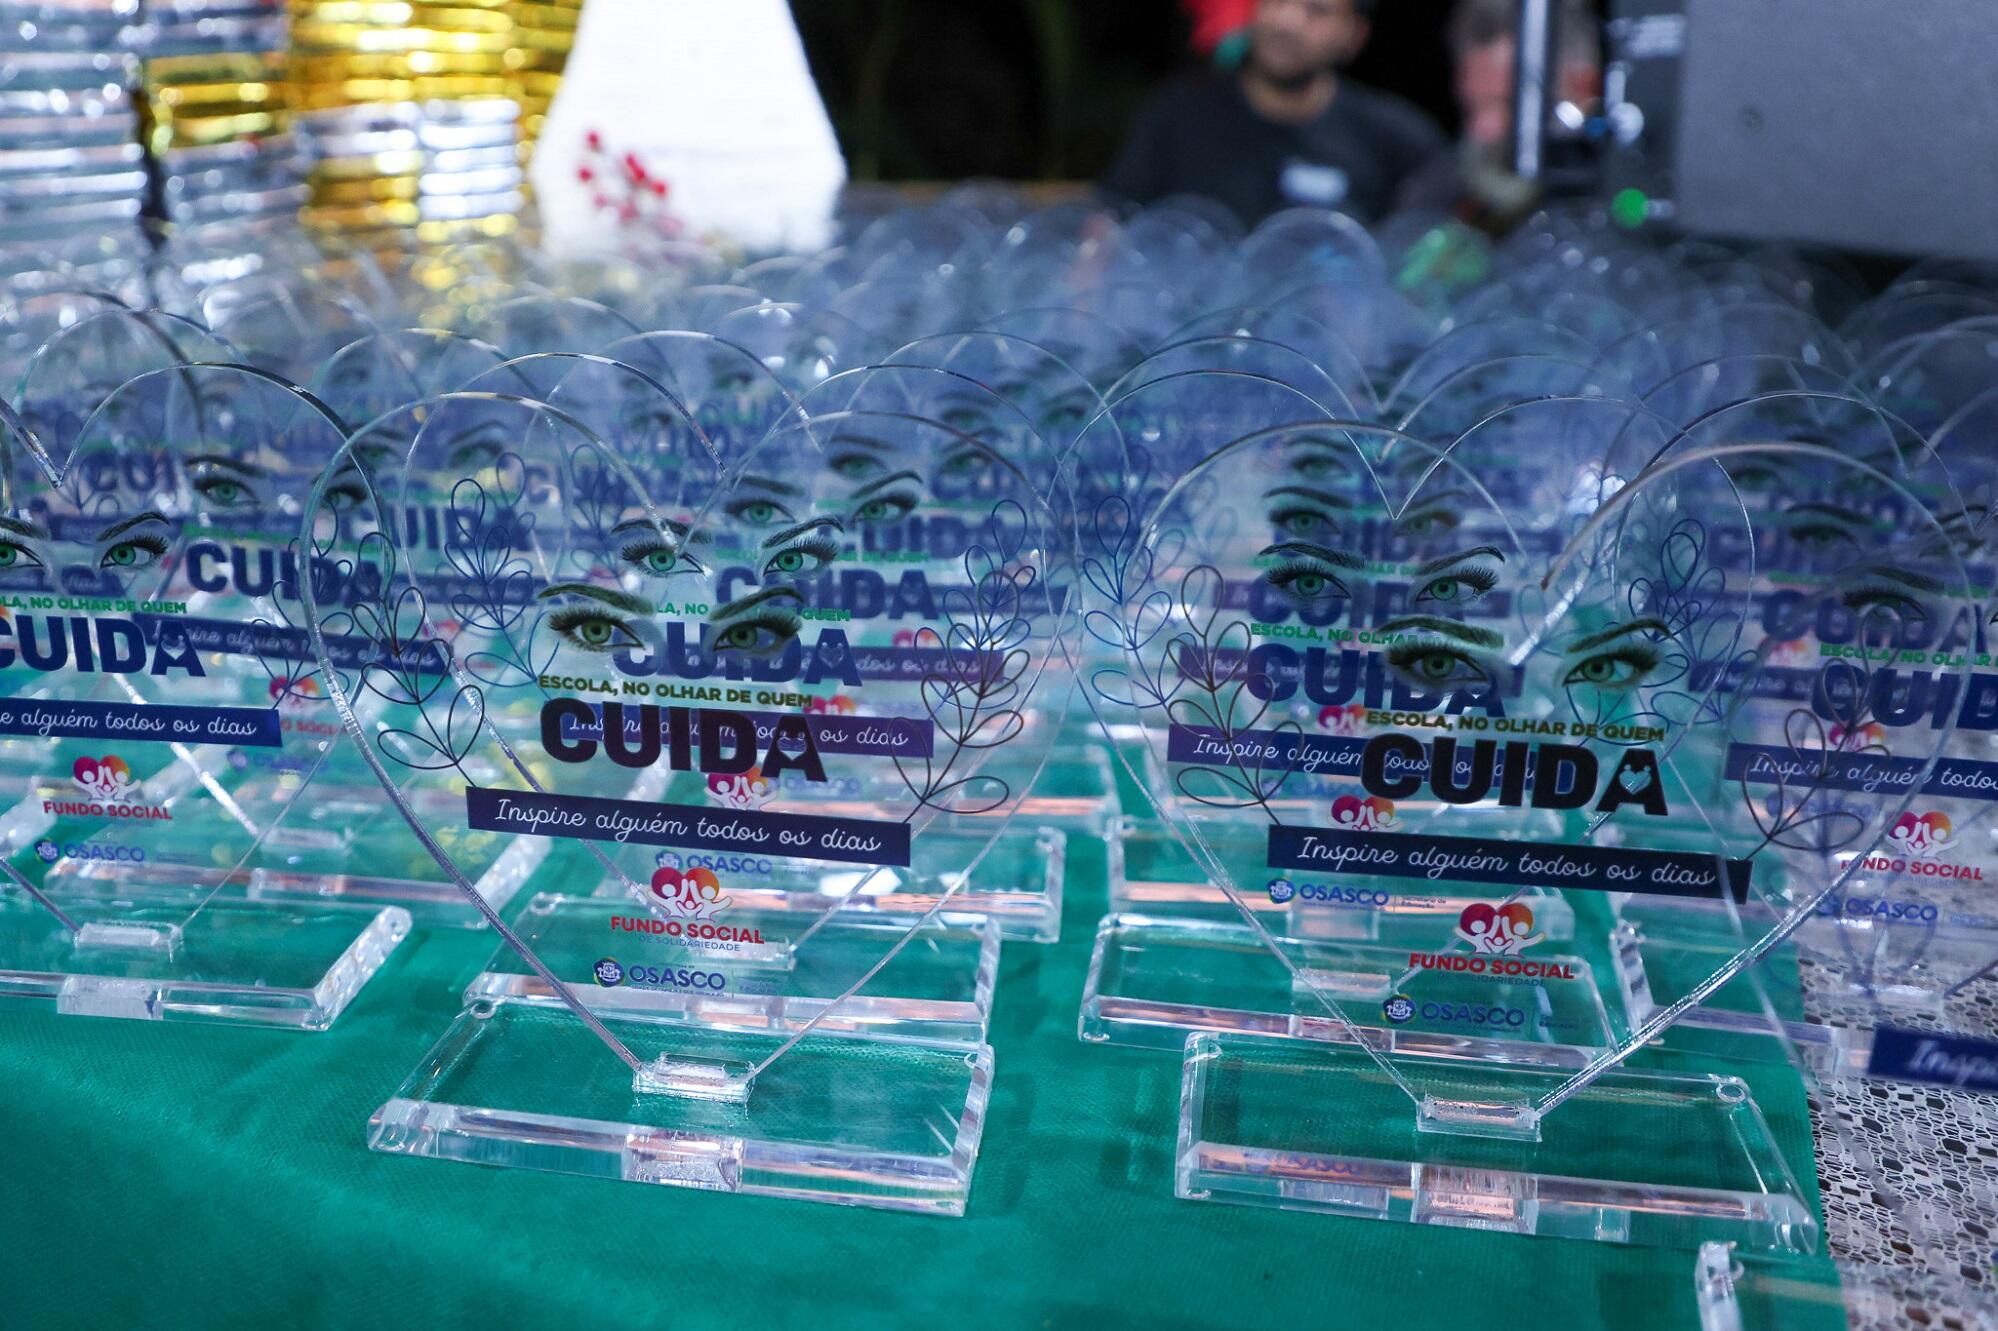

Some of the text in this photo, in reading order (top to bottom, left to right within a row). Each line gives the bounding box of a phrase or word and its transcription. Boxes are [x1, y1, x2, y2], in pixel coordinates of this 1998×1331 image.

[30, 596, 53, 609] NO
[58, 599, 112, 612] OLHAR
[116, 601, 136, 613] DE
[142, 601, 187, 614] QUEM
[685, 603, 709, 615] NO
[801, 607, 851, 622] QUEM
[1328, 628, 1354, 642] NO
[1820, 643, 1894, 662] ESCOLA
[539, 675, 813, 707] ESCOLA, NO OLHAR DE QUEM
[21, 708, 98, 736] alguém
[105, 710, 165, 731] todos
[173, 717, 200, 731] os
[208, 716, 257, 735] dias
[1365, 710, 1665, 742] ESCOLA, NO OLHAR DE QUEM
[540, 697, 828, 783] CUIDA
[819, 728, 849, 743] os
[856, 724, 909, 746] dias
[1193, 733, 1280, 764] Inspire
[1360, 732, 1668, 816] CUIDA
[43, 801, 173, 821] FUNDO SOCIAL
[495, 798, 882, 852] Inspire alguém todos os dias
[64, 843, 145, 863] OSASCO
[1296, 836, 1717, 886] Inspire alguém todos os dias
[1840, 857, 1984, 881] FNDO SOCIAL
[1299, 883, 1389, 906] OSASCO
[1845, 897, 1938, 922] OSASCO
[611, 916, 765, 945] FUNDO SOCIAL
[656, 937, 741, 952] SOLIDARIEDADE
[628, 964, 726, 991] OSASCO
[1409, 952, 1575, 979] FUNDO SOCIAL
[1420, 1001, 1526, 1027] OSASCO
